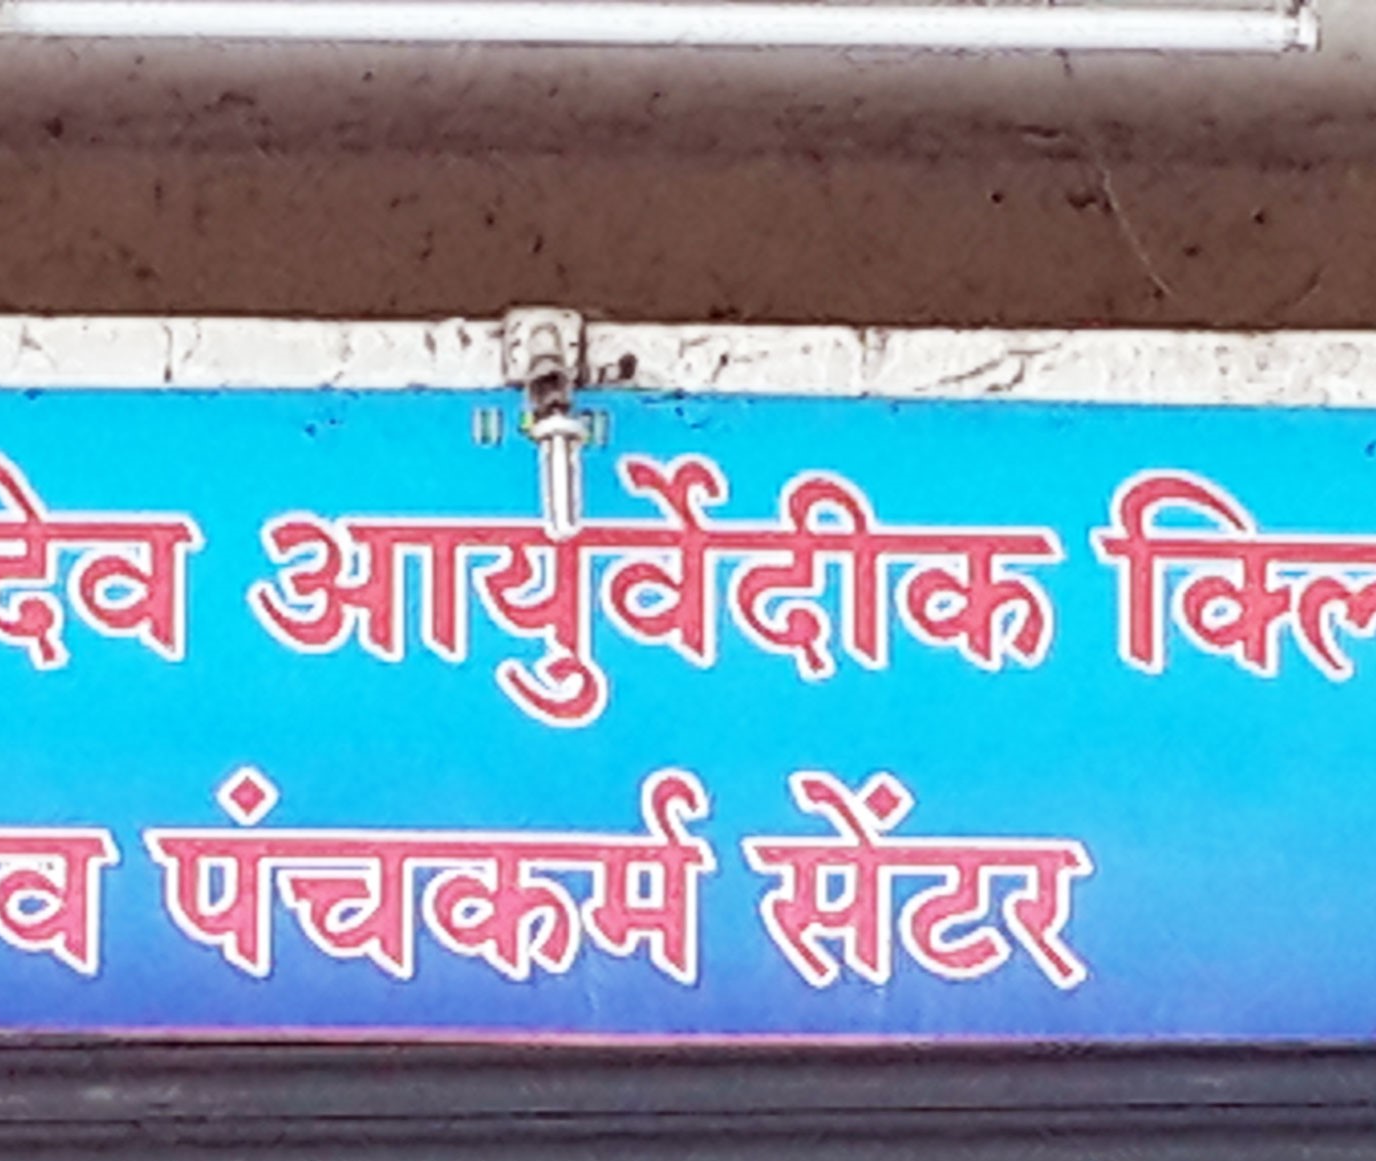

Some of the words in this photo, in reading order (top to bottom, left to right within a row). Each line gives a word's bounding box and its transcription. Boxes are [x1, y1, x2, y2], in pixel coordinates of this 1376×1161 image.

[250, 453, 1062, 726] आयुर्वेदीक
[145, 769, 715, 981] पंचकर्म
[744, 772, 1091, 988] सेंटर
